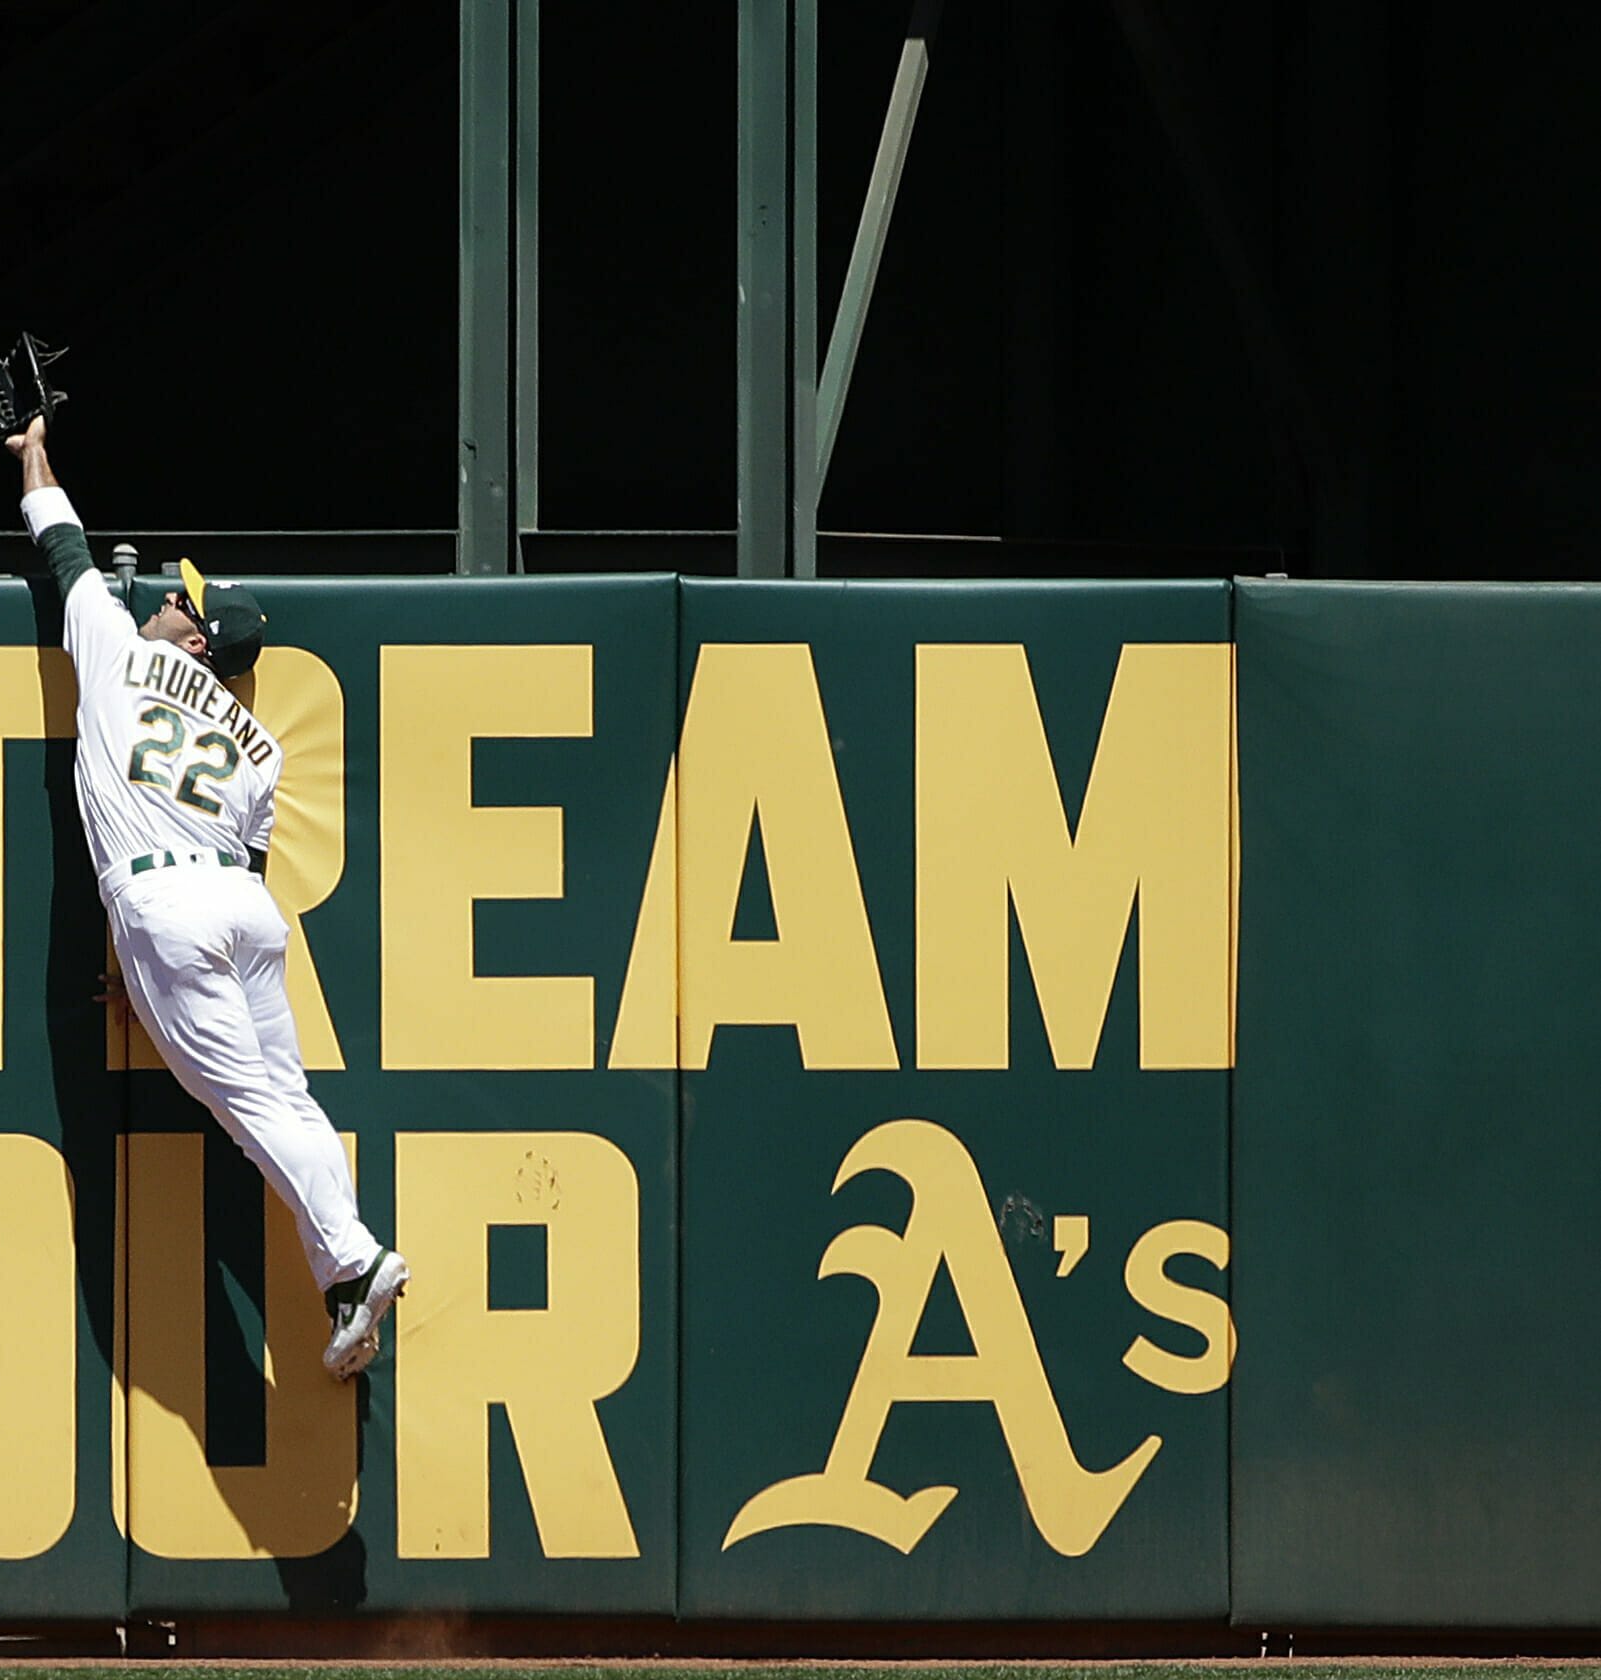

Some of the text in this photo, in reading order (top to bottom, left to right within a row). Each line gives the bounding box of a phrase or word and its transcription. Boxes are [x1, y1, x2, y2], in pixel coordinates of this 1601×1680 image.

[123, 650, 274, 768] LAUREANO
[128, 702, 241, 818] 22
[721, 1118, 1239, 1558] A's
